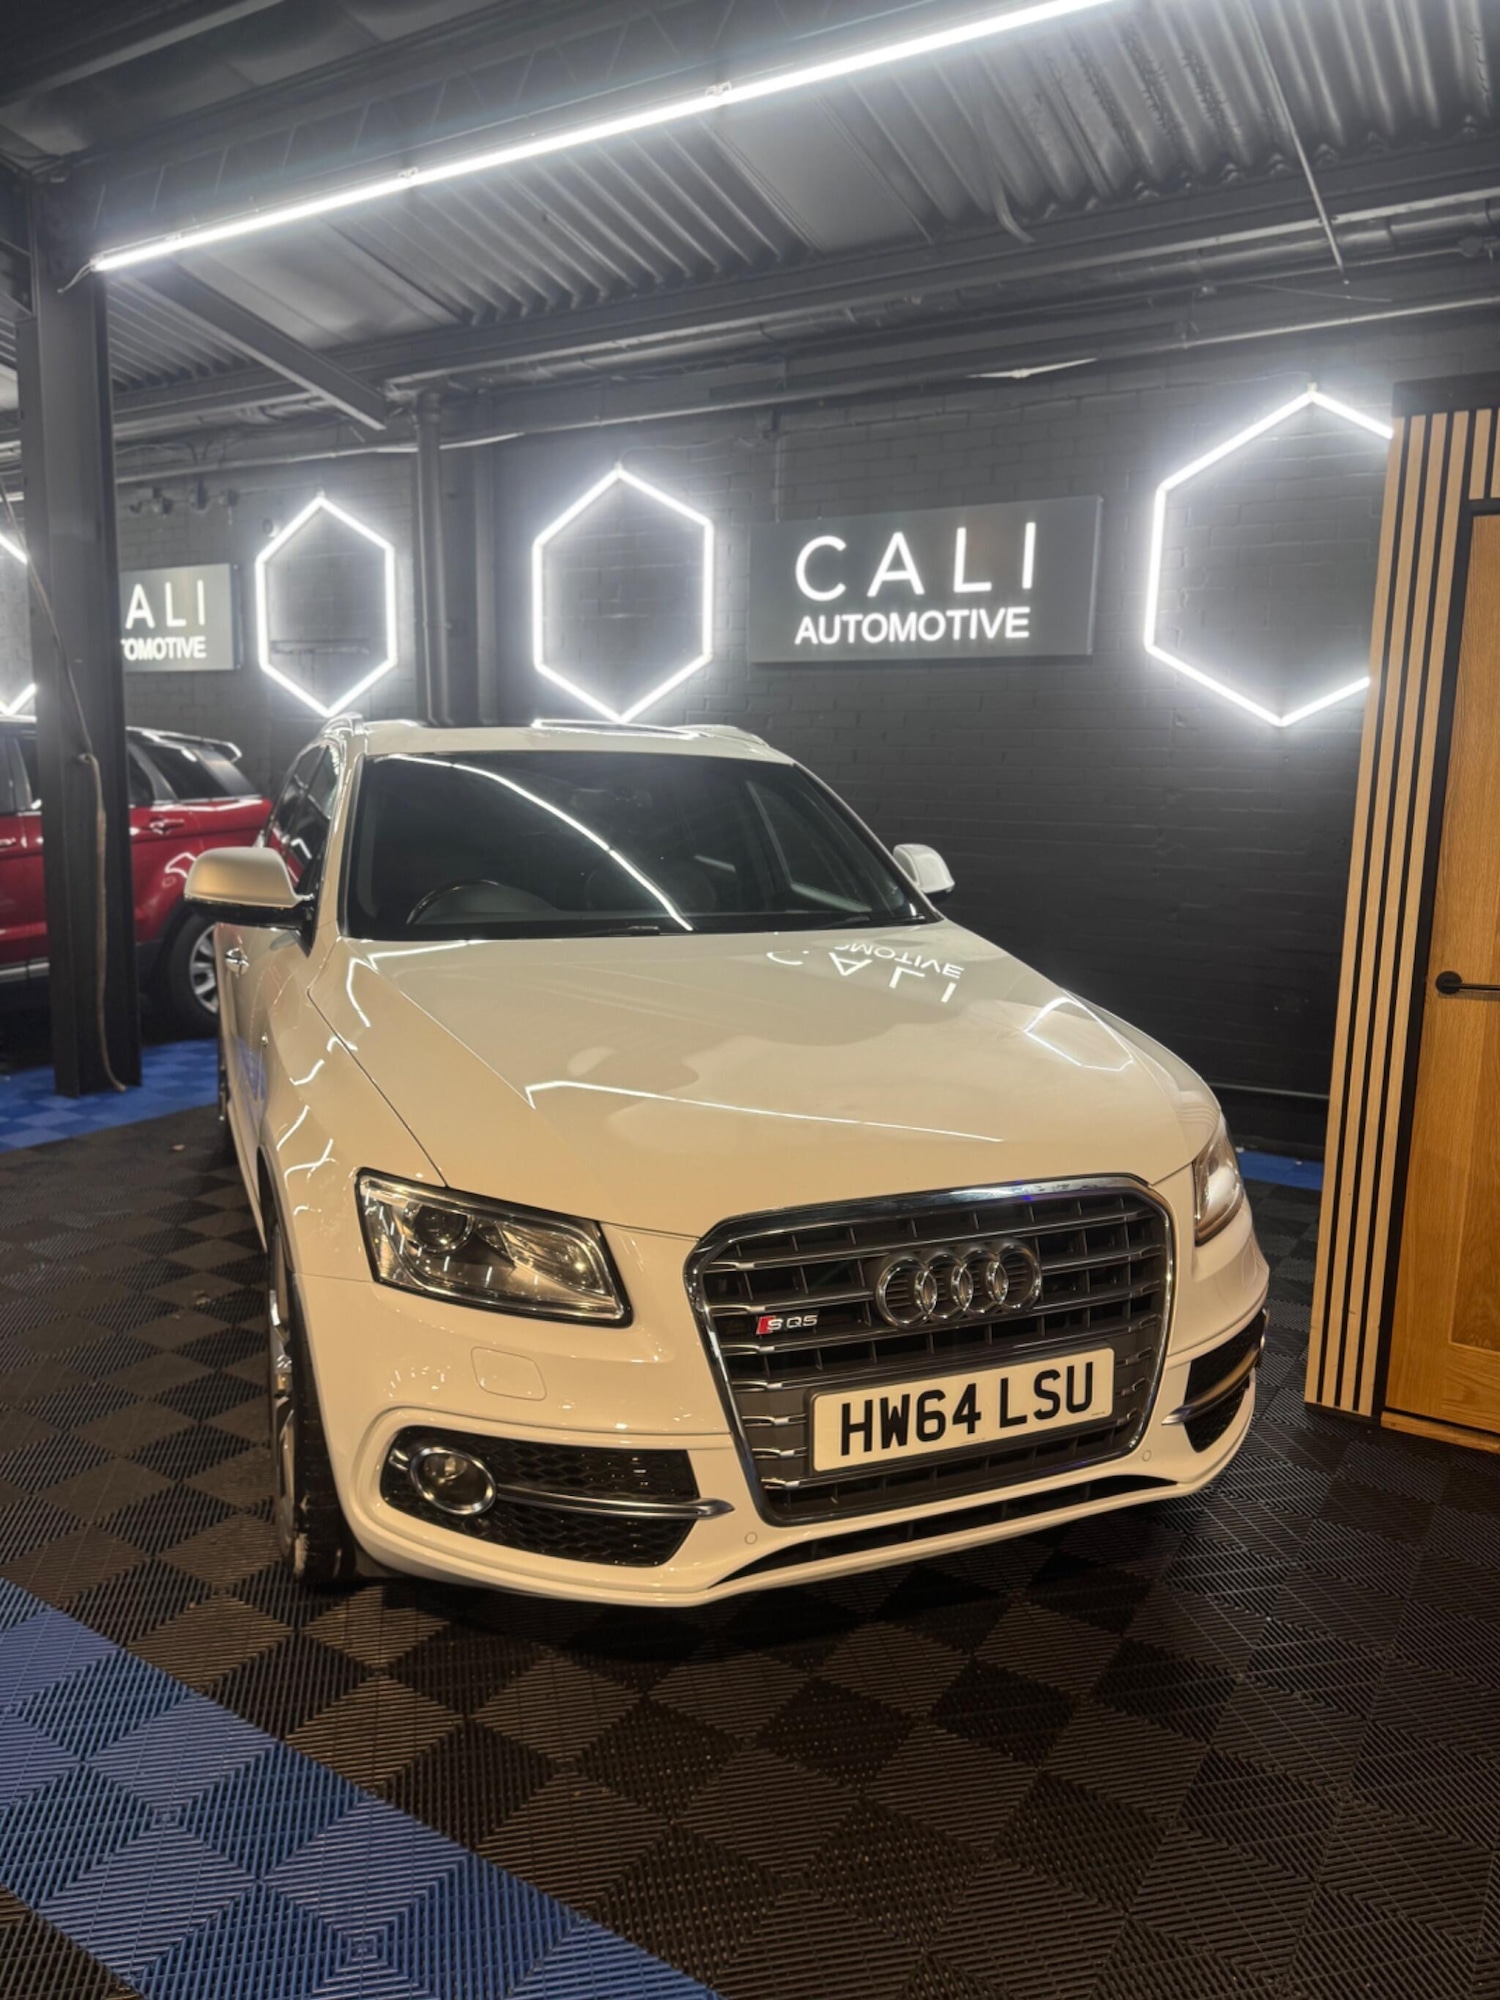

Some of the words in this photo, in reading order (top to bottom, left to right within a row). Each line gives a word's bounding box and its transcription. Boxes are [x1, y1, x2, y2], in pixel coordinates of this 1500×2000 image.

[795, 522, 1036, 601] CALI
[125, 579, 205, 630] ALI
[794, 606, 1031, 645] AUTOMOTIVE
[120, 635, 207, 661] OMOTIVE
[767, 1314, 818, 1331] SQ5
[840, 1382, 982, 1456] HW64
[999, 1361, 1094, 1428] LSU
